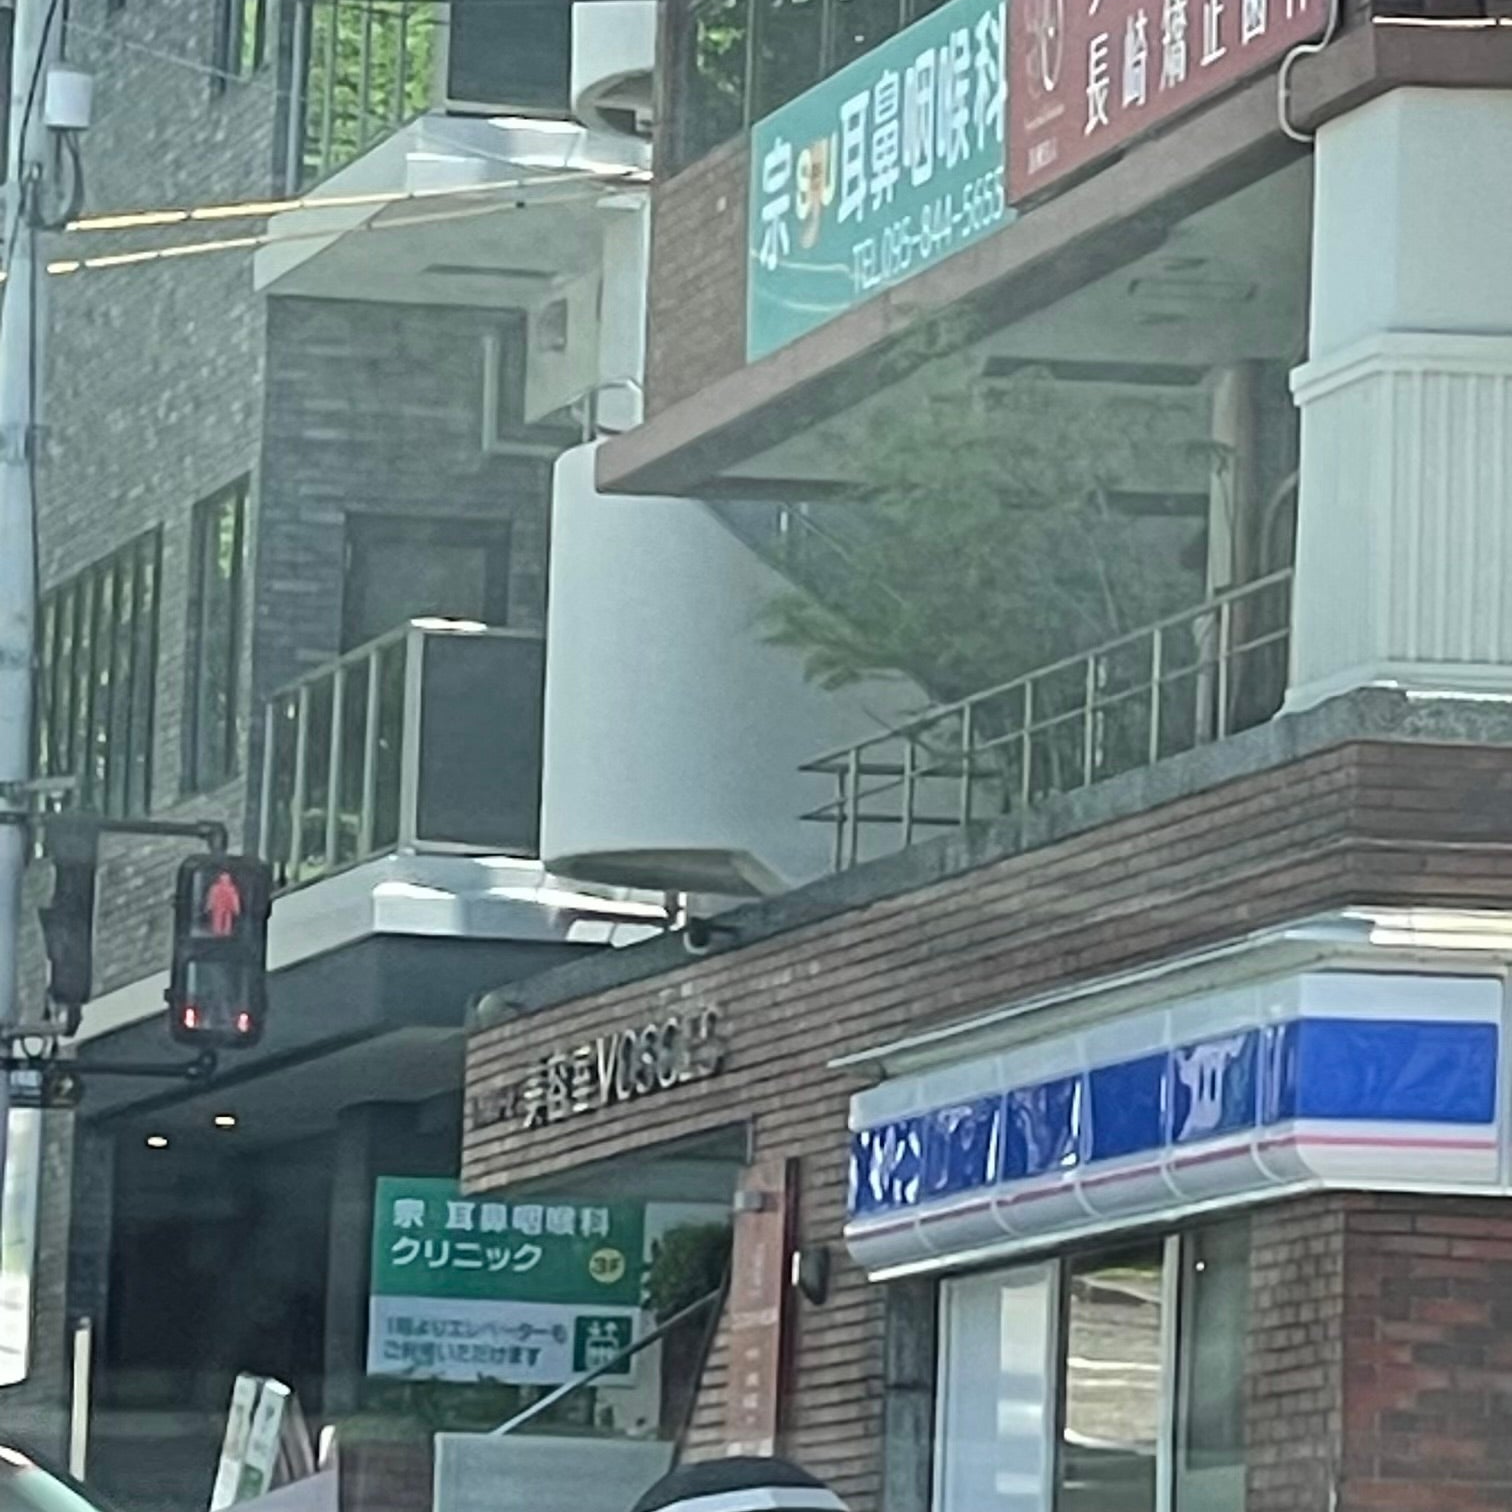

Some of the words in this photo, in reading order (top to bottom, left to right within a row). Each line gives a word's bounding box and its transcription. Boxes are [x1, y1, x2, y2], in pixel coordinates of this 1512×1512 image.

[391, 1235, 544, 1272] クリニック
